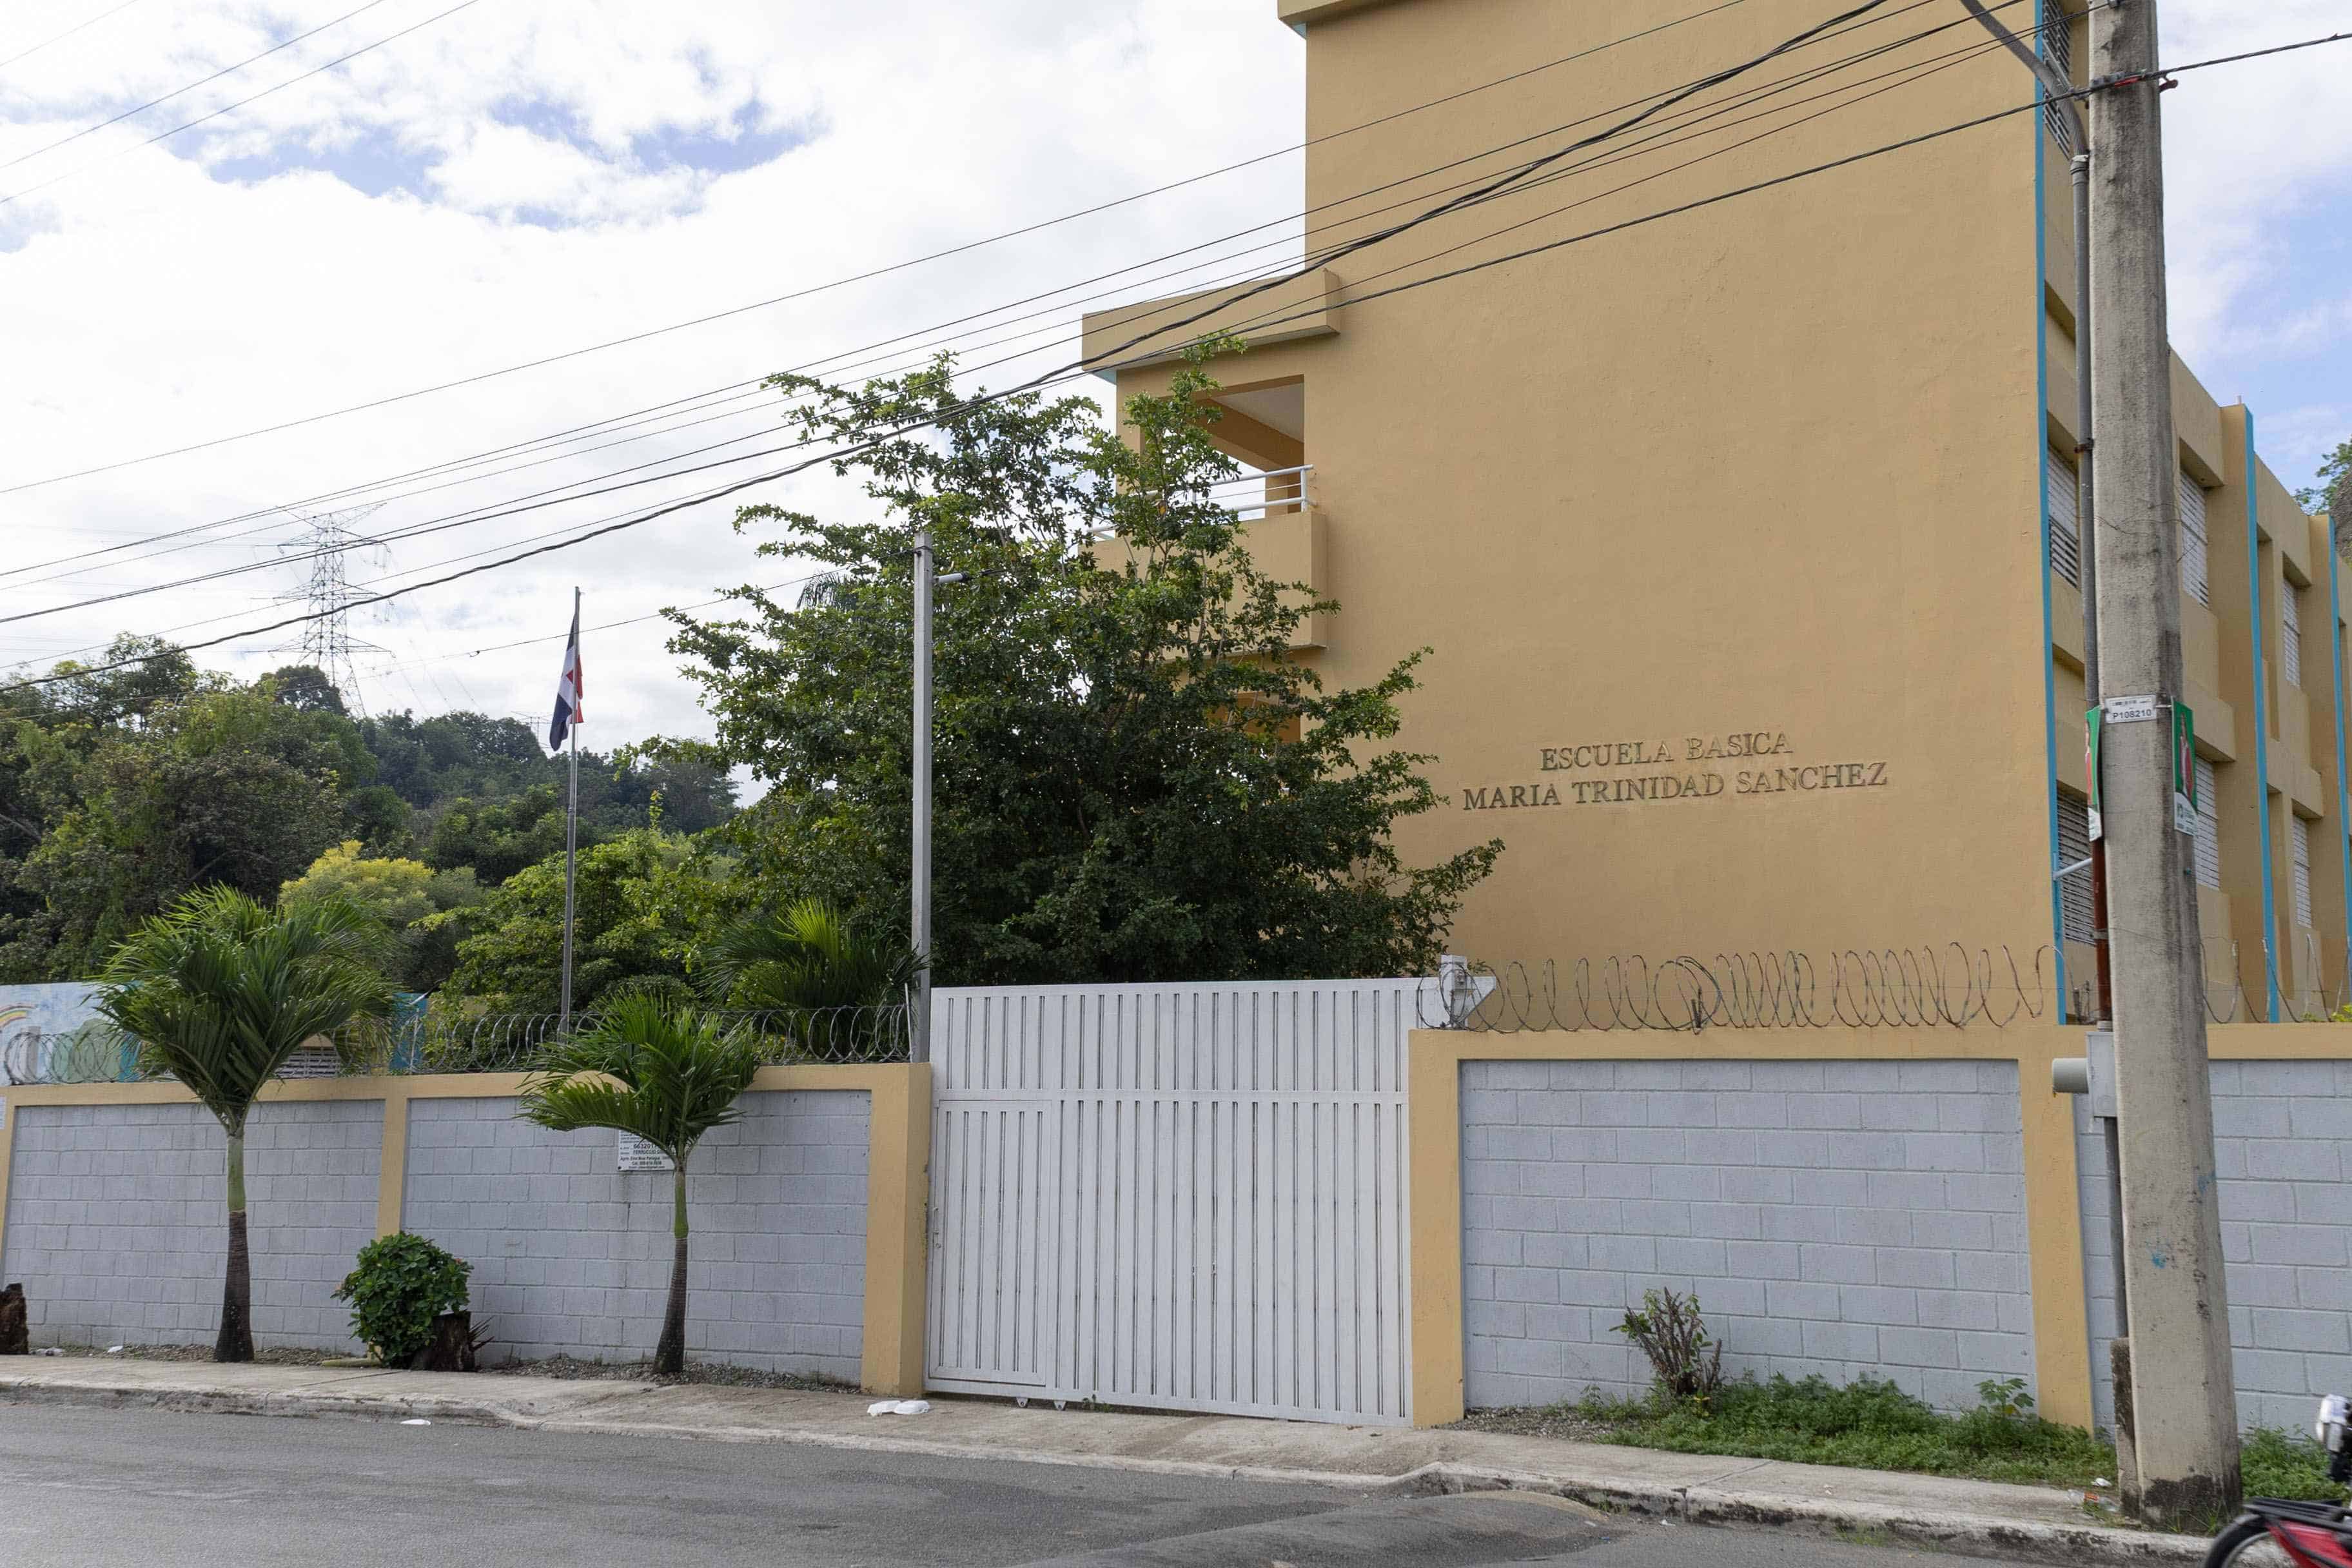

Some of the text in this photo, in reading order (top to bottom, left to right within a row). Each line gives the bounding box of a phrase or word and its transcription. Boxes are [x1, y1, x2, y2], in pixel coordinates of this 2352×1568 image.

[1540, 731, 1793, 770] ESCUELA BASICA
[1462, 761, 1888, 810] MARIA TRINIDAD SANCHEZ
